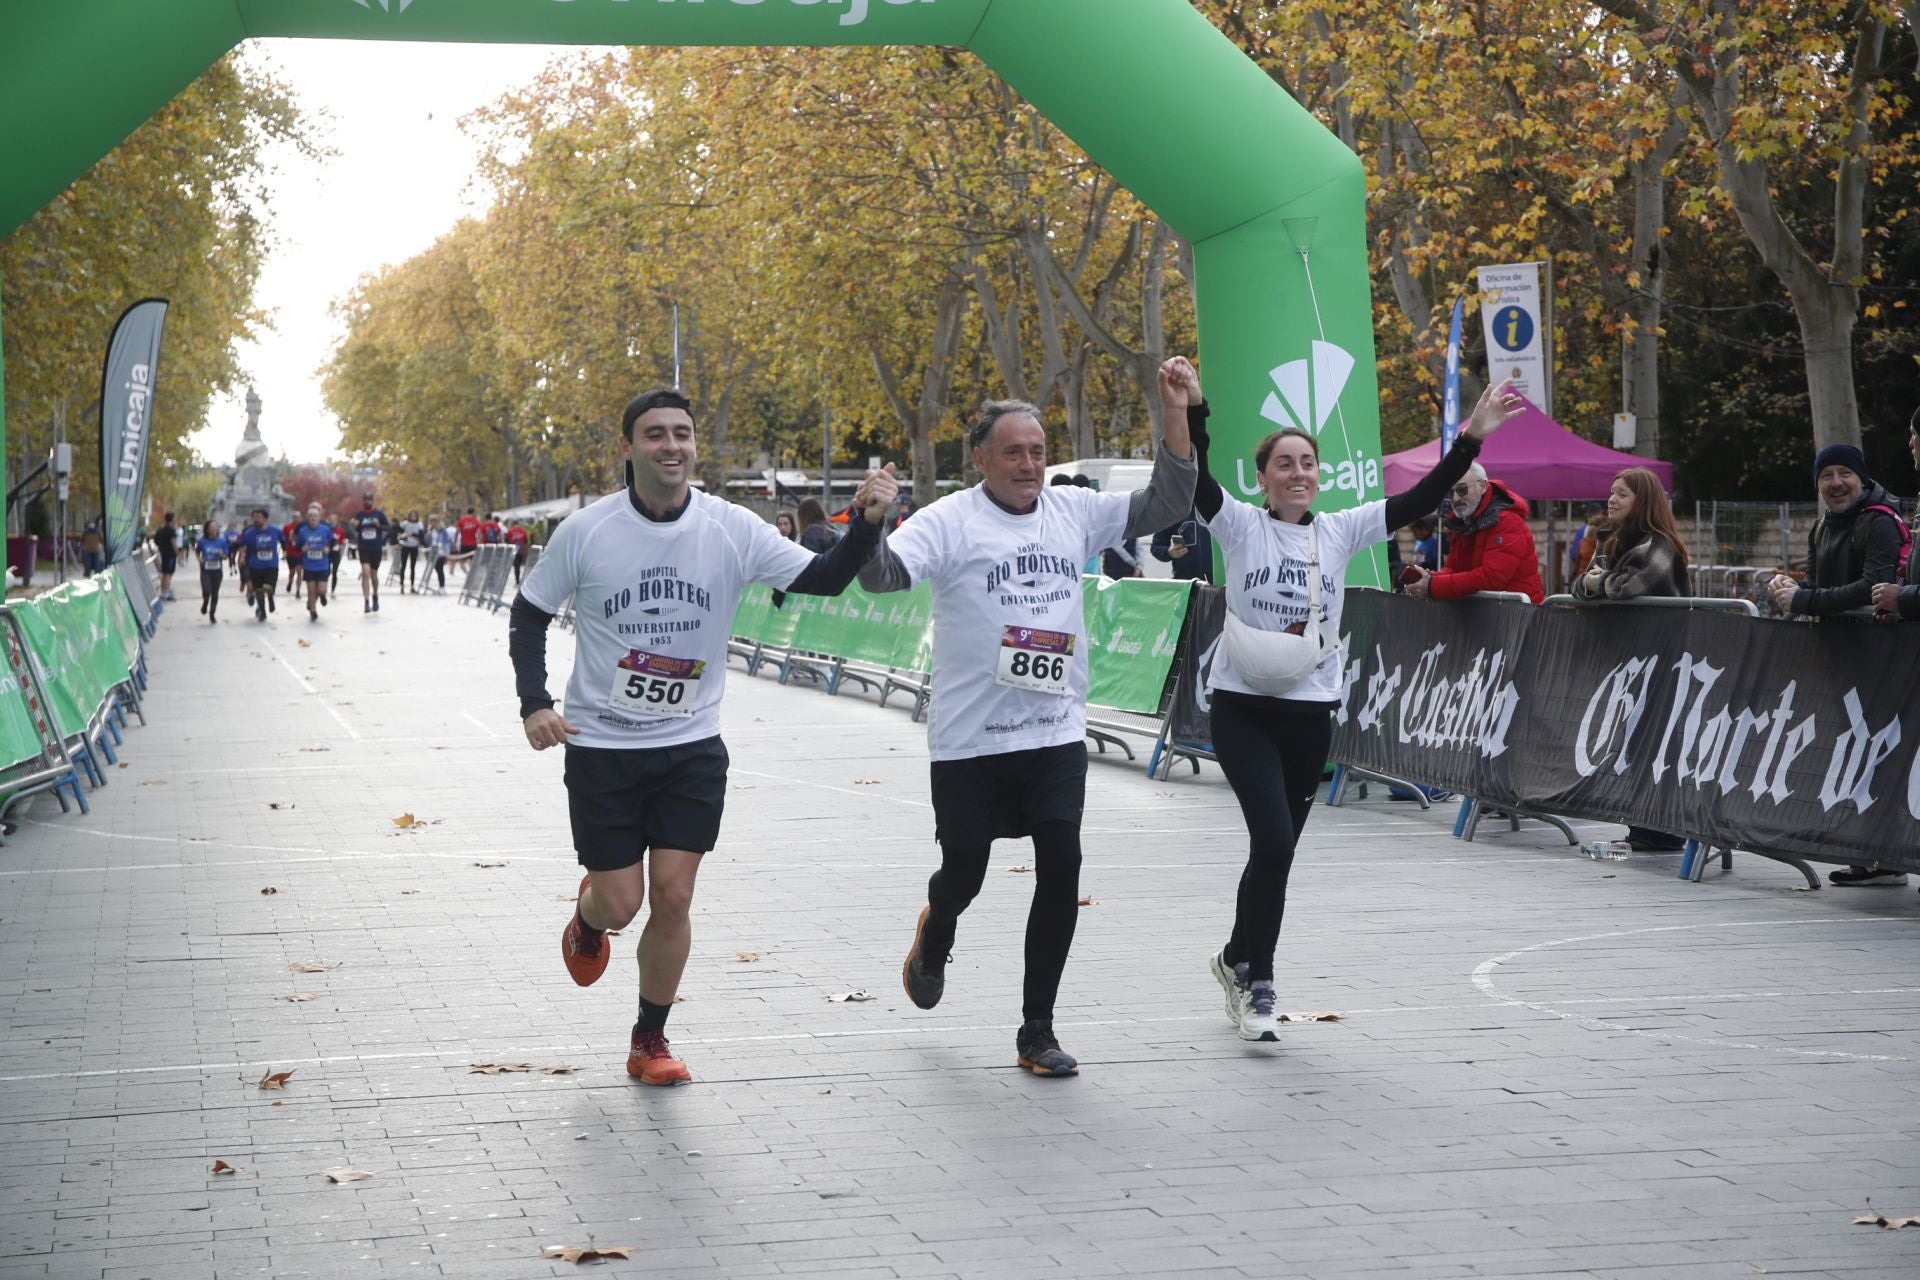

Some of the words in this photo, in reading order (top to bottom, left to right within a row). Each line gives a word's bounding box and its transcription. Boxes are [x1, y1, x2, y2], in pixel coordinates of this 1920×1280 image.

[1485, 274, 1511, 282] Oficina
[1512, 272, 1522, 281] de
[118, 363, 151, 486] Unicaja
[1236, 450, 1379, 501] Ucaja
[641, 566, 679, 580] HOSPITAL
[987, 560, 1011, 594] RIO
[1244, 566, 1271, 592] RIO
[604, 587, 631, 619] RIO
[639, 578, 711, 613] HORTEGA
[1031, 606, 1050, 616] 1953
[618, 619, 701, 635] UNIVERSITARIO
[650, 636, 672, 646] 1953
[1010, 651, 1065, 682] 866
[624, 673, 685, 705] 550
[1358, 643, 1402, 737] de
[1575, 653, 1660, 778] El
[1652, 651, 1816, 807] Norte
[1818, 686, 1902, 816] de
